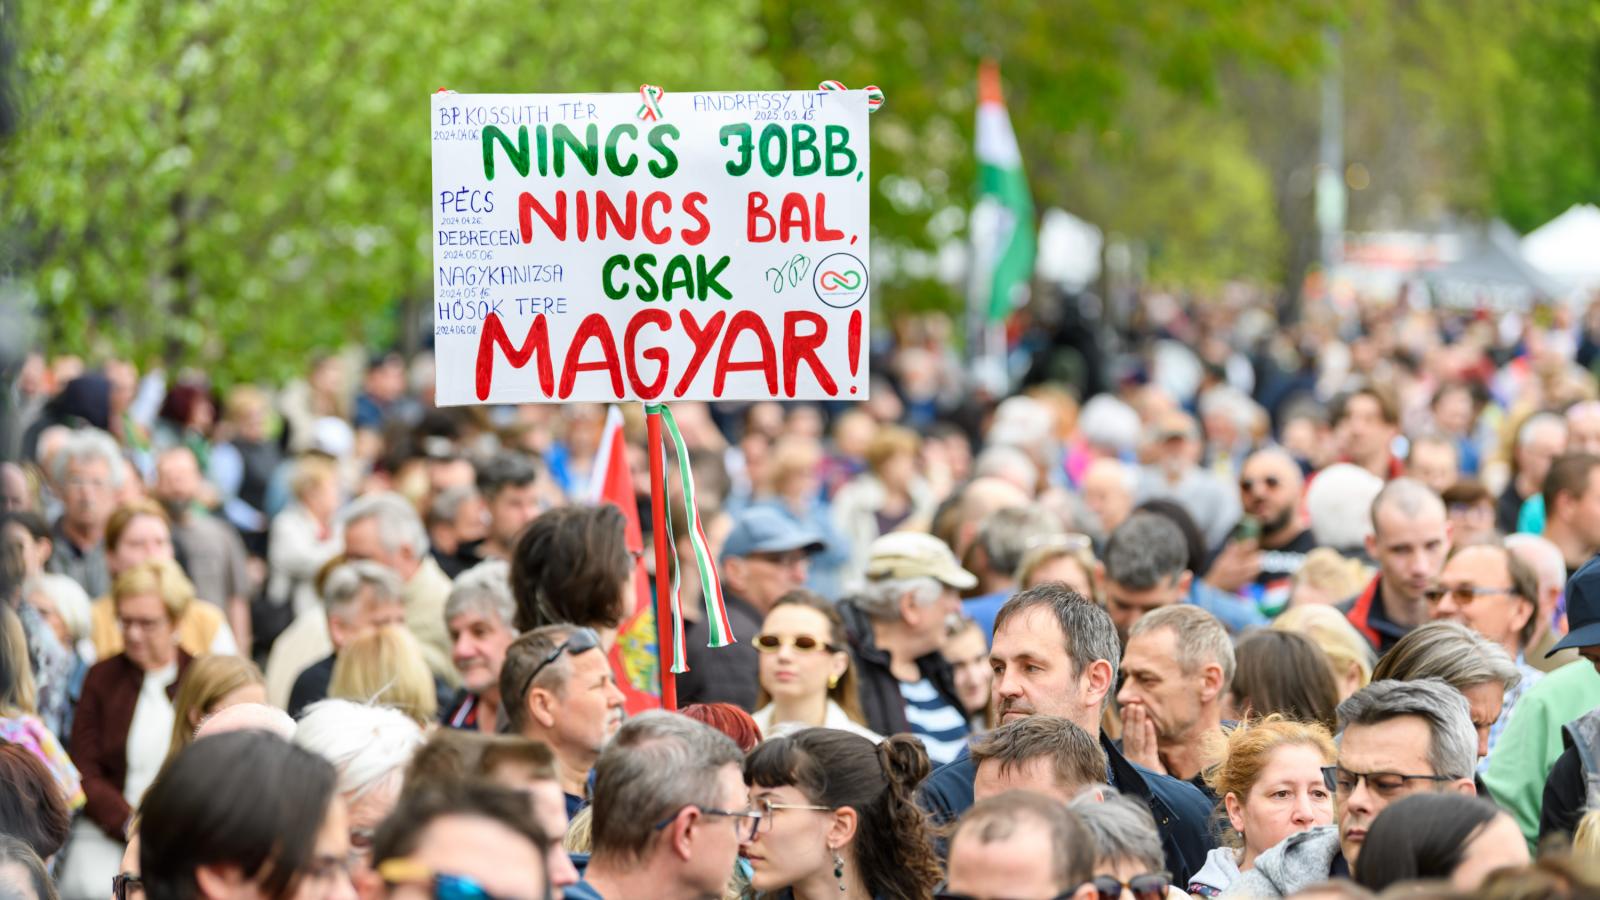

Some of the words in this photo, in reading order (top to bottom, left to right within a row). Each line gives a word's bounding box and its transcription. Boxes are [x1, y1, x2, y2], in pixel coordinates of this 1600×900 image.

[559, 100, 599, 120] TÉR
[694, 93, 792, 112] ANDRÁSSY
[802, 92, 829, 110] ÚT
[482, 125, 679, 181] NINCS
[720, 124, 864, 182] JOBB,
[440, 186, 494, 214] PÉCS
[519, 191, 710, 245] NINCS
[747, 192, 857, 244] BAL,
[438, 229, 520, 246] DEBRECEN
[439, 264, 563, 287] NAGYKANIZSA
[603, 254, 732, 302] CSAK
[515, 297, 568, 316] TERE
[476, 309, 862, 400] MAGYAR!
